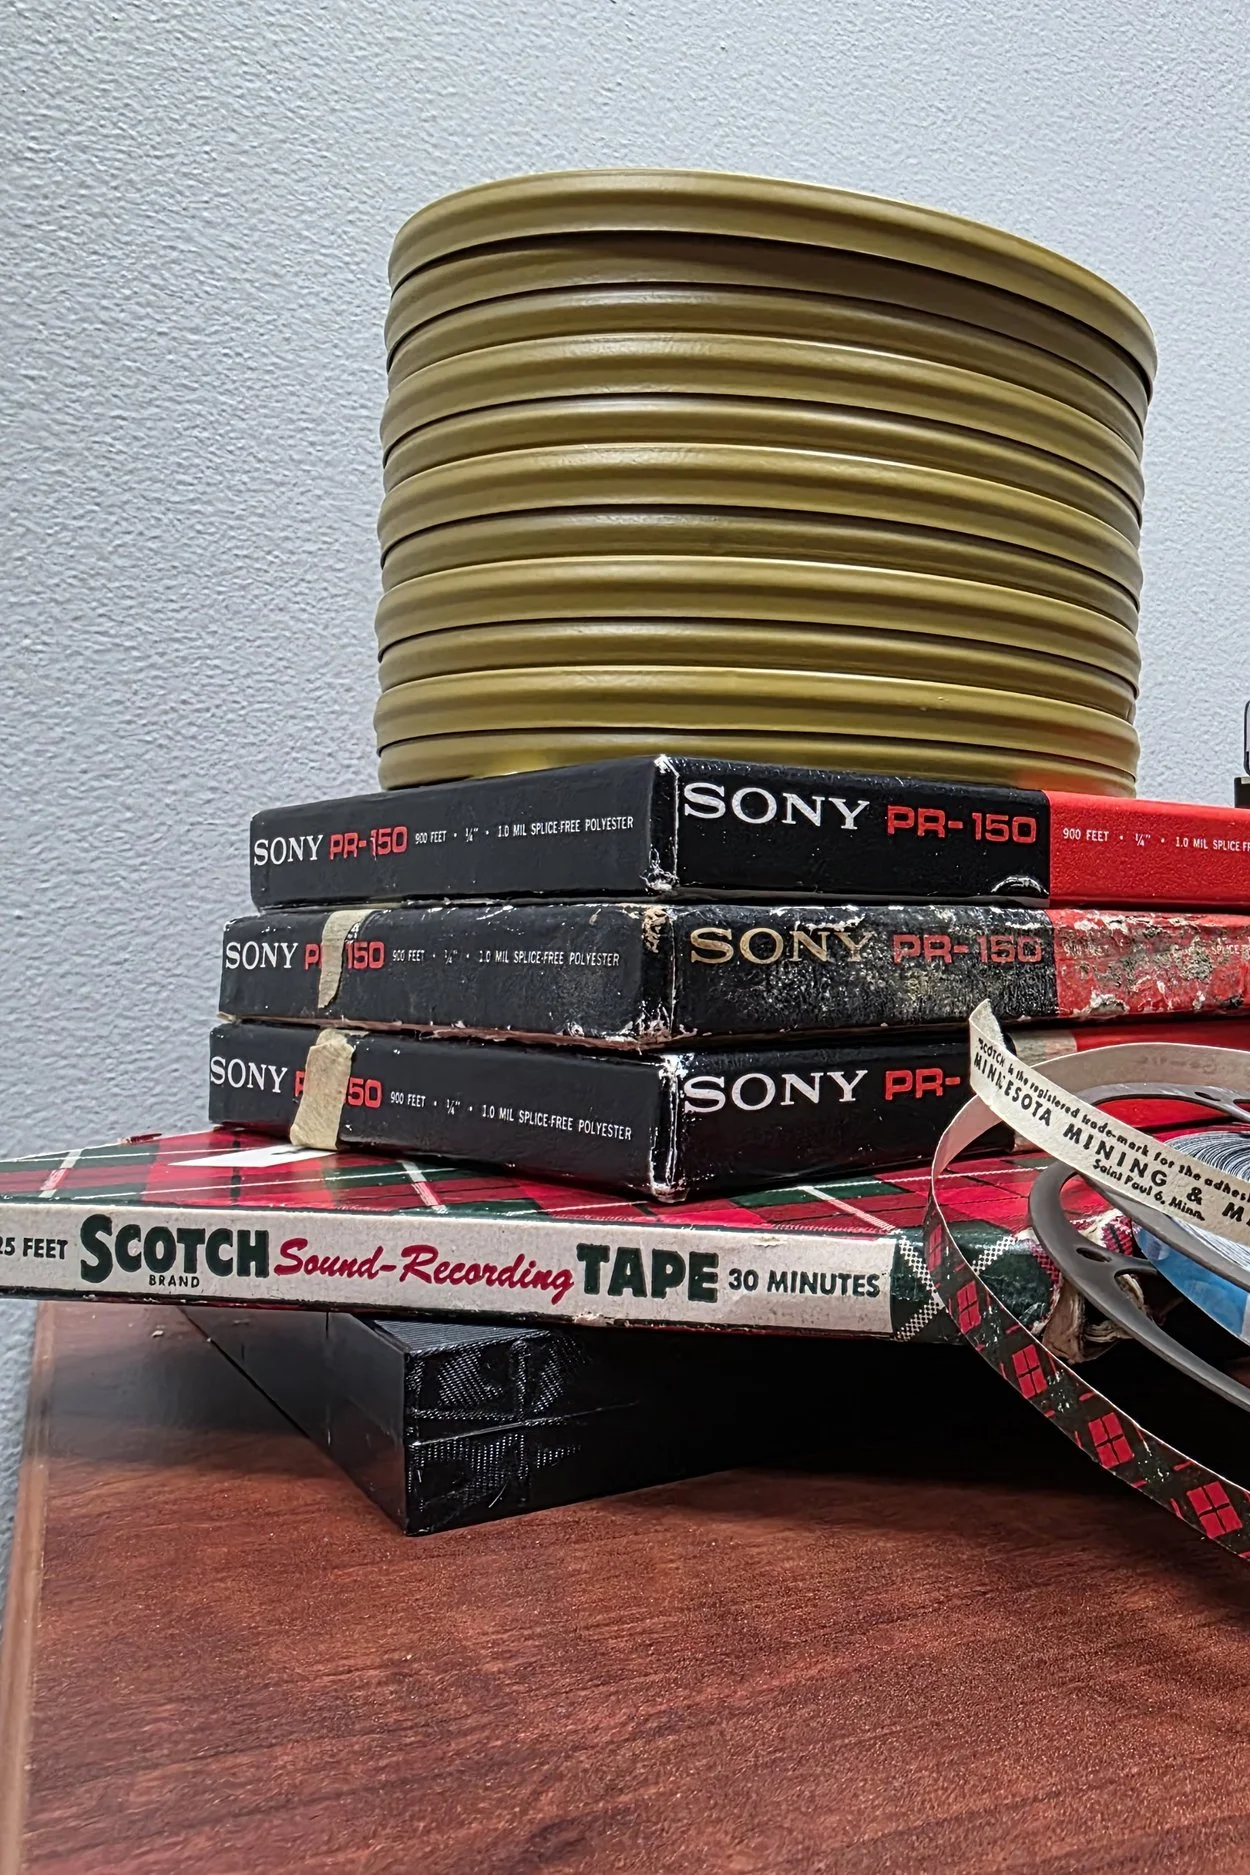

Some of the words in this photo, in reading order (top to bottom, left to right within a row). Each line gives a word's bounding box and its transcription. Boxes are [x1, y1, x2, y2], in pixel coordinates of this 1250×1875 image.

[683, 782, 870, 830] SONY
[886, 805, 1037, 844] PR-150
[254, 835, 323, 866] SONY
[329, 826, 408, 861] PR-150
[415, 832, 427, 844] 900
[430, 831, 447, 843] FEET
[497, 825, 510, 838] 1.0
[513, 823, 527, 837] MIL
[530, 819, 581, 835] SPLICE-FREE
[585, 816, 634, 832] POLYESTER
[1063, 828, 1081, 840] 900
[1086, 830, 1109, 842] FEET
[1175, 836, 1188, 848] 1.0
[1193, 838, 1208, 849] MIL
[225, 941, 298, 970] SONY
[304, 941, 385, 970] P150
[408, 950, 425, 962] FEET
[495, 951, 509, 963] MIL
[514, 951, 564, 965] SPLICE-FREE
[569, 952, 620, 966] POLYESTER
[690, 927, 877, 965] SONY
[893, 934, 1042, 965] PR-150
[210, 1056, 288, 1093] SONY
[390, 1091, 404, 1104] 900
[408, 1093, 426, 1107] FEET
[482, 1104, 495, 1119] 1.0
[499, 1107, 514, 1121] MIL
[519, 1110, 573, 1131] SPLICE-FREE
[578, 1120, 632, 1141] POLYESTER
[683, 1069, 868, 1113] SONY
[974, 1052, 1052, 1126] MINNESOTA
[1063, 1123, 1167, 1187] MINING
[1186, 1187, 1202, 1205] &
[1016, 1070, 1028, 1085] the
[1030, 1082, 1080, 1118] registered
[1082, 1114, 1149, 1157] trade-mark
[1154, 1152, 1175, 1168] for
[1178, 1164, 1201, 1181] the
[1093, 1159, 1122, 1181] Saint
[1124, 1175, 1152, 1196] Paul
[23, 1237, 68, 1259] FEET
[81, 1214, 269, 1283] SCOTCH
[274, 1237, 574, 1305] Sound-Recording
[576, 1243, 719, 1303] TAPE
[728, 1268, 759, 1292] 30
[767, 1270, 880, 1297] MINUTES
[149, 1275, 199, 1288] BRAND
